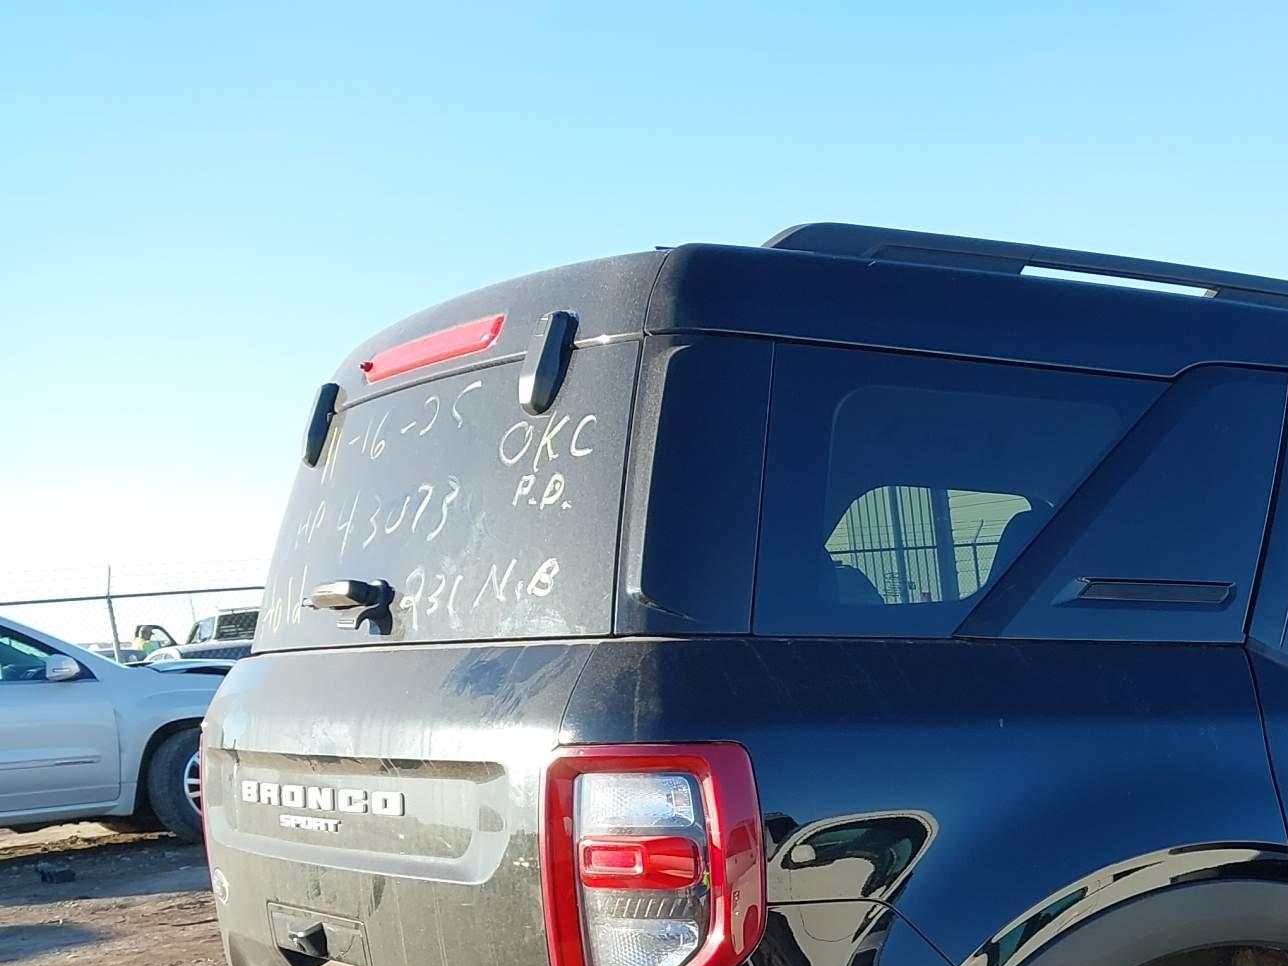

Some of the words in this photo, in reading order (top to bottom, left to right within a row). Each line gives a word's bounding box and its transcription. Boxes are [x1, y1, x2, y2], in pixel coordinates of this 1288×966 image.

[499, 410, 598, 473] OKC
[241, 779, 406, 817] BRONCO
[279, 814, 342, 833] SPORT
